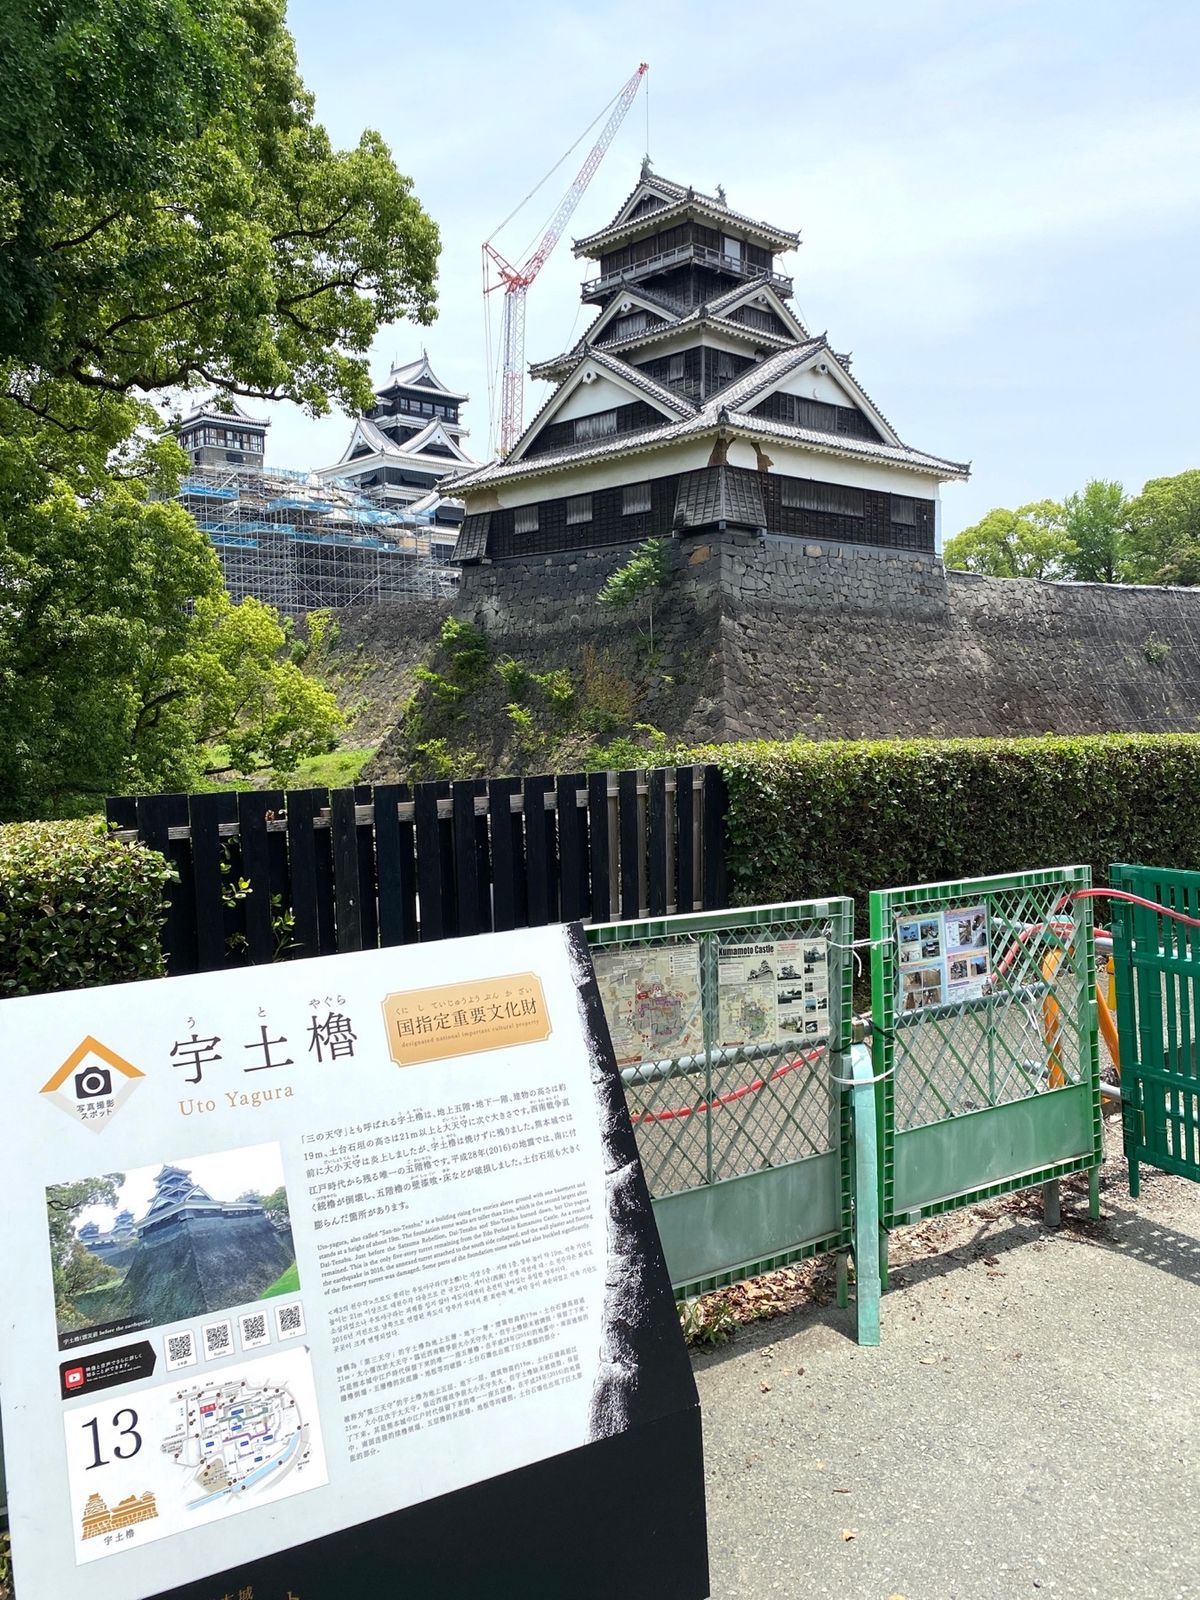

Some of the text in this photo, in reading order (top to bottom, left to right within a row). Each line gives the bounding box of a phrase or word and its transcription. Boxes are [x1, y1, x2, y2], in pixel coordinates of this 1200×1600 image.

[719, 946, 754, 956] Kumamoto
[755, 944, 774, 954] Castle
[187, 995, 346, 1028] う と やぐら
[397, 997, 536, 1037] 国指定重要文化財
[170, 1012, 357, 1084] 宇土櫓
[401, 1018, 539, 1048] designated national important cultural property
[76, 1099, 114, 1112] 写真撮影
[80, 1106, 112, 1120] スポット
[178, 1086, 294, 1116] Uto Yagura
[318, 1250, 336, 1260] stands
[348, 1244, 365, 1252] height
[371, 1238, 387, 1247] about
[412, 1225, 440, 1237] foundation
[476, 1212, 490, 1221] taller
[490, 1210, 502, 1218] than
[543, 1196, 560, 1204] second
[349, 1235, 361, 1243] also
[362, 1231, 378, 1240] called
[434, 1212, 456, 1223] building
[515, 1194, 532, 1203] ground
[397, 1239, 420, 1250] Satsuma
[519, 1210, 537, 1219] burned
[553, 1203, 563, 1211] but
[433, 1238, 460, 1250] remaining
[459, 1234, 472, 1243] from
[472, 1232, 482, 1240] the
[482, 1229, 493, 1237] Edo
[493, 1224, 510, 1234] Period
[571, 1206, 585, 1214] result
[332, 1272, 362, 1284] earthquake
[434, 1248, 455, 1258] attached
[470, 1240, 484, 1249] south
[550, 1221, 565, 1229] plaster
[436, 1258, 450, 1267] parts
[466, 1246, 494, 1259] foundation
[542, 1230, 560, 1239] buckled
[82, 1408, 143, 1471] 13
[104, 1529, 135, 1546] 宇土櫓
